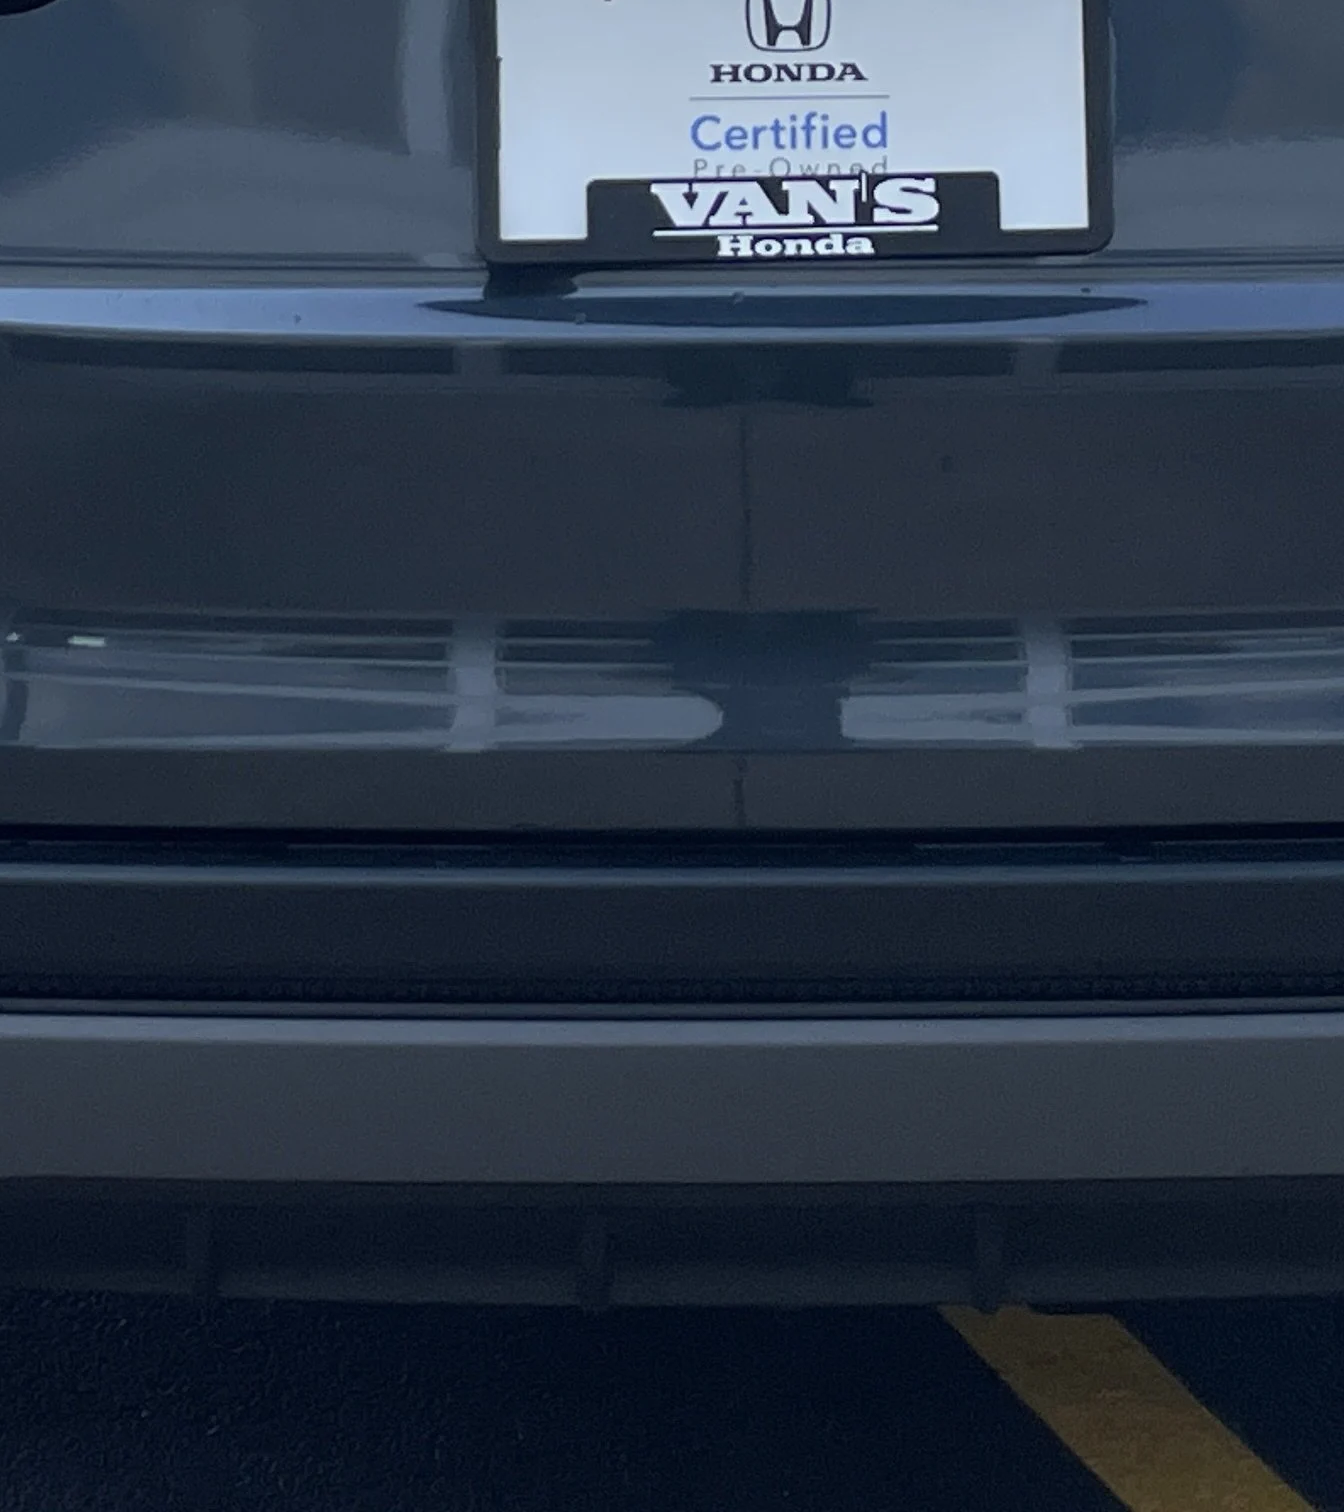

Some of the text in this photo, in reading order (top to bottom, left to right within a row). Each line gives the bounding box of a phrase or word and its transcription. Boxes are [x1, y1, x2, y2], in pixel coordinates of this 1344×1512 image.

[709, 61, 869, 85] HONDA
[690, 111, 889, 152] Certified
[650, 171, 939, 227] VAN'S
[717, 233, 875, 259] Honda
